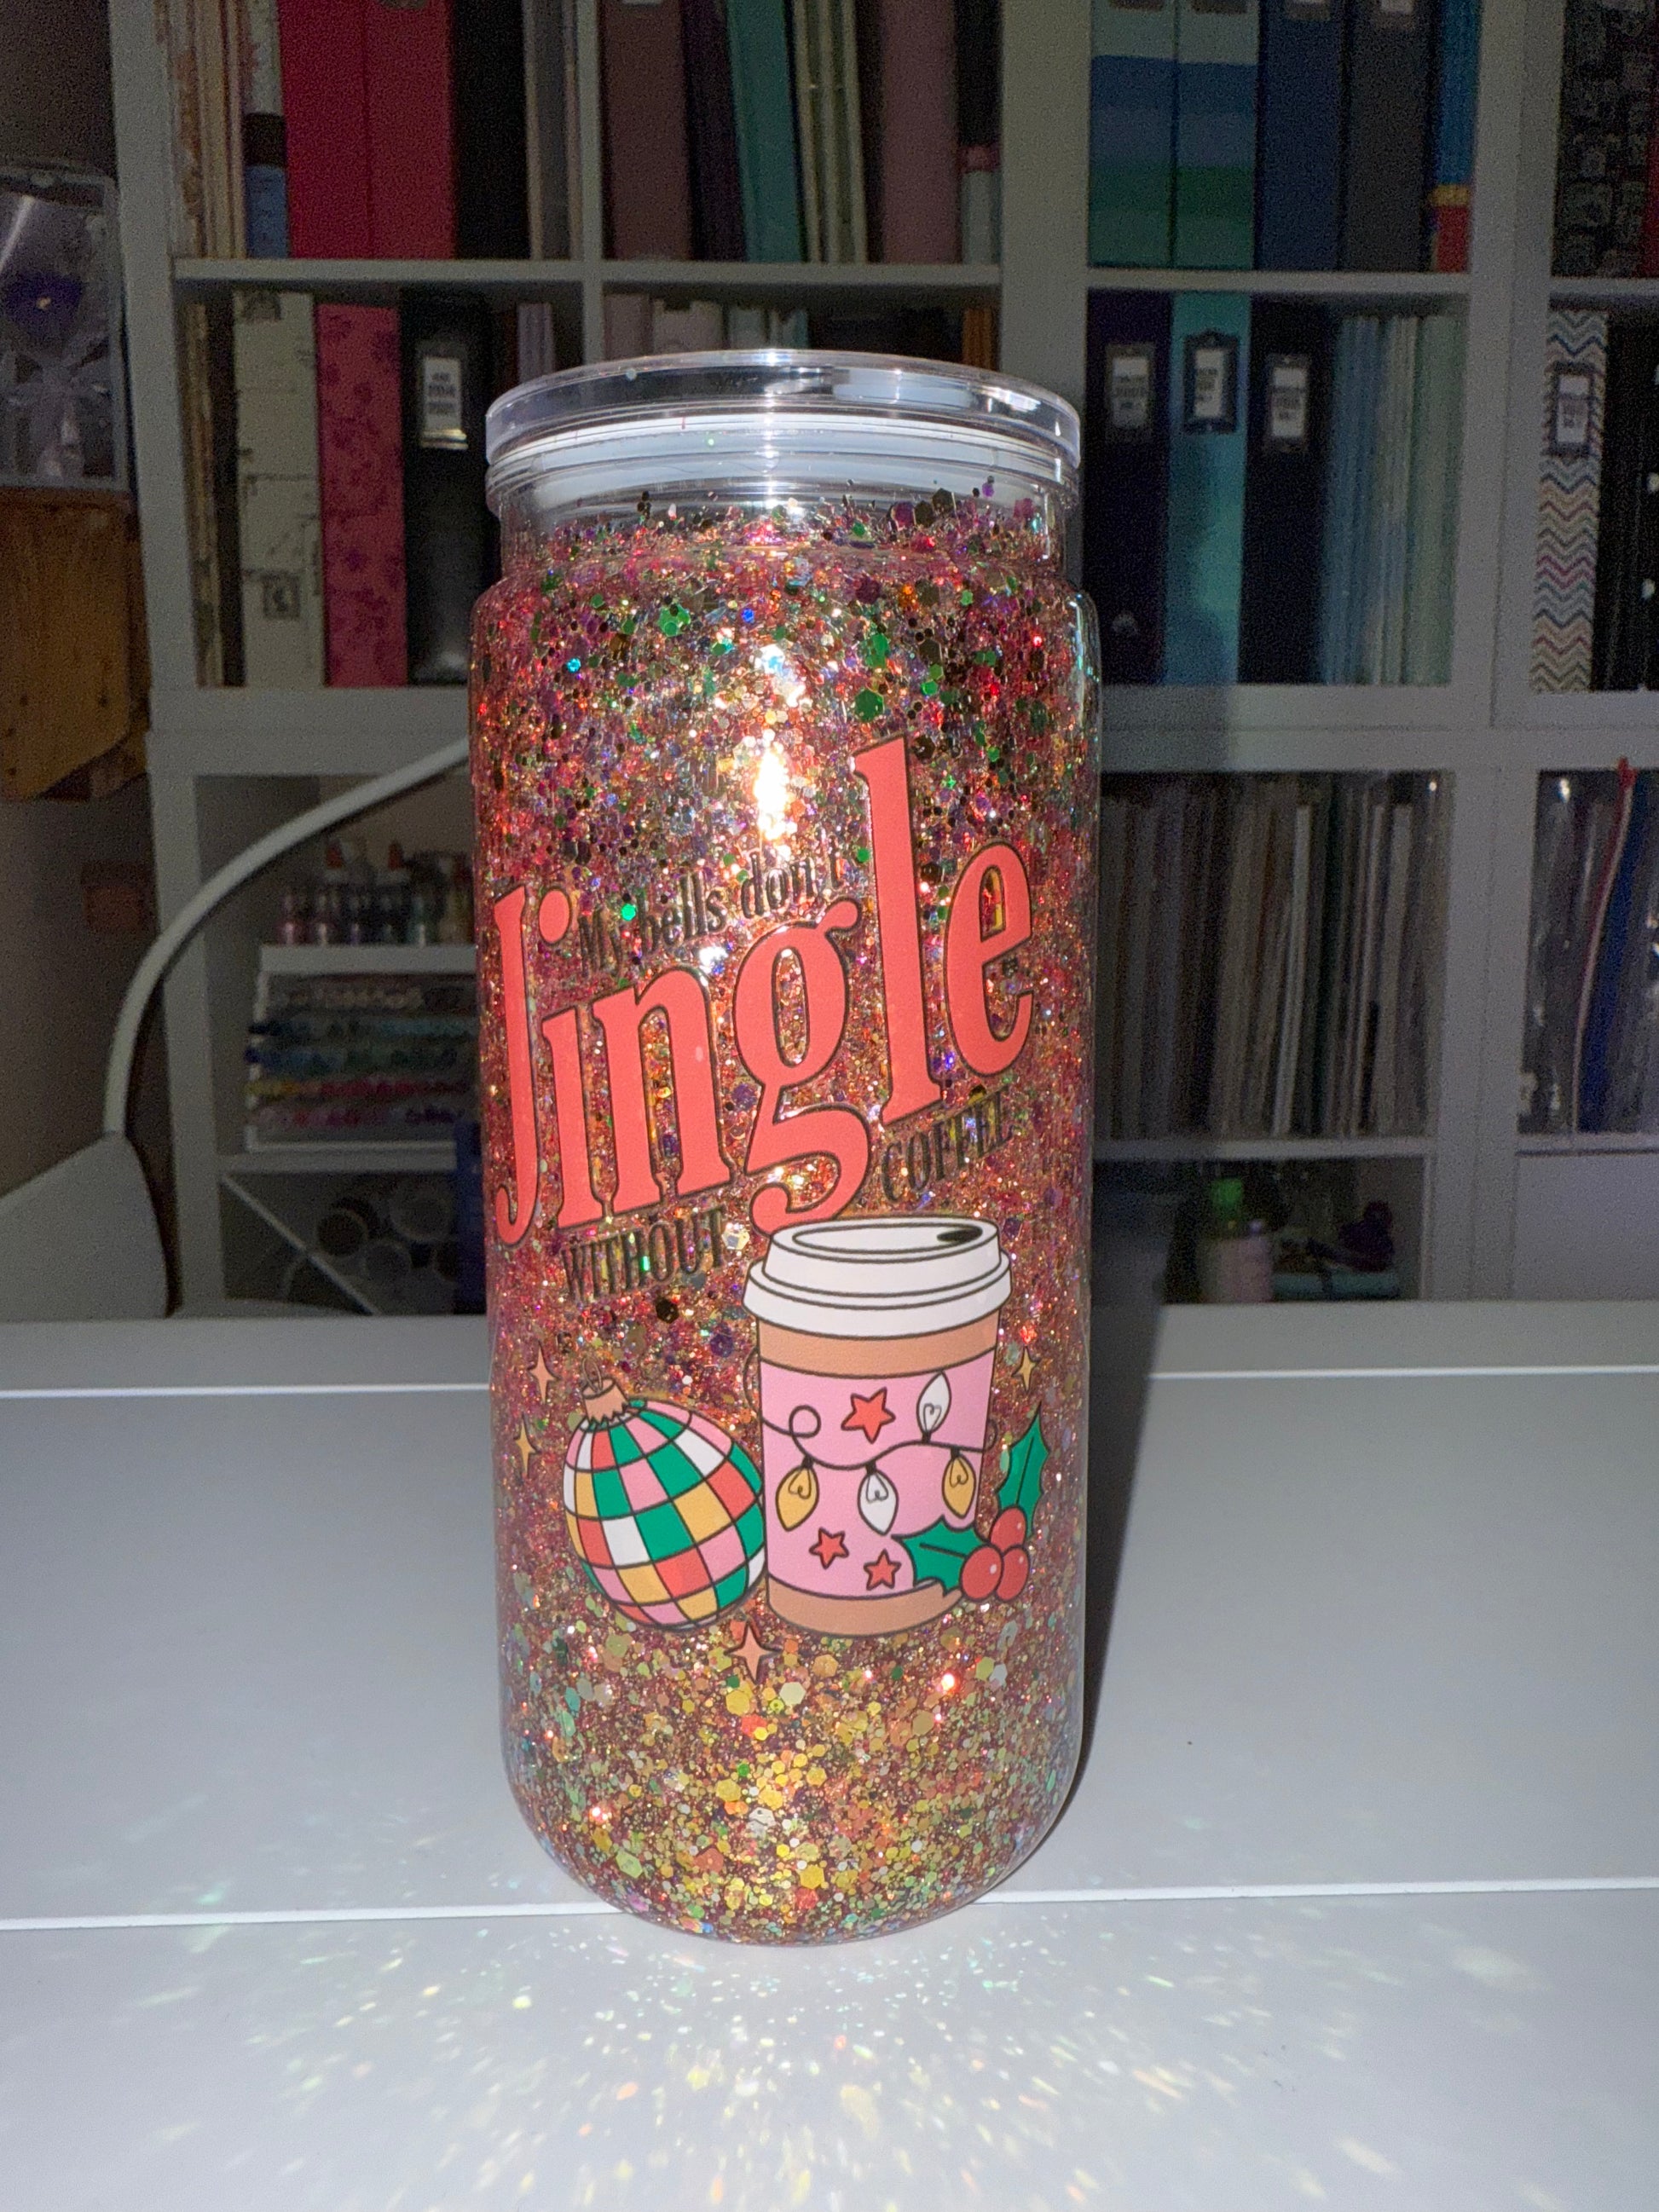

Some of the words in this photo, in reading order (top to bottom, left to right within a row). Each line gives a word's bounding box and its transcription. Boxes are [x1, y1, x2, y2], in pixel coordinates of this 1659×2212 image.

[636, 869, 725, 953] bells
[561, 1205, 725, 1302] WITHOUT
[881, 1086, 1017, 1203] COFFEE
